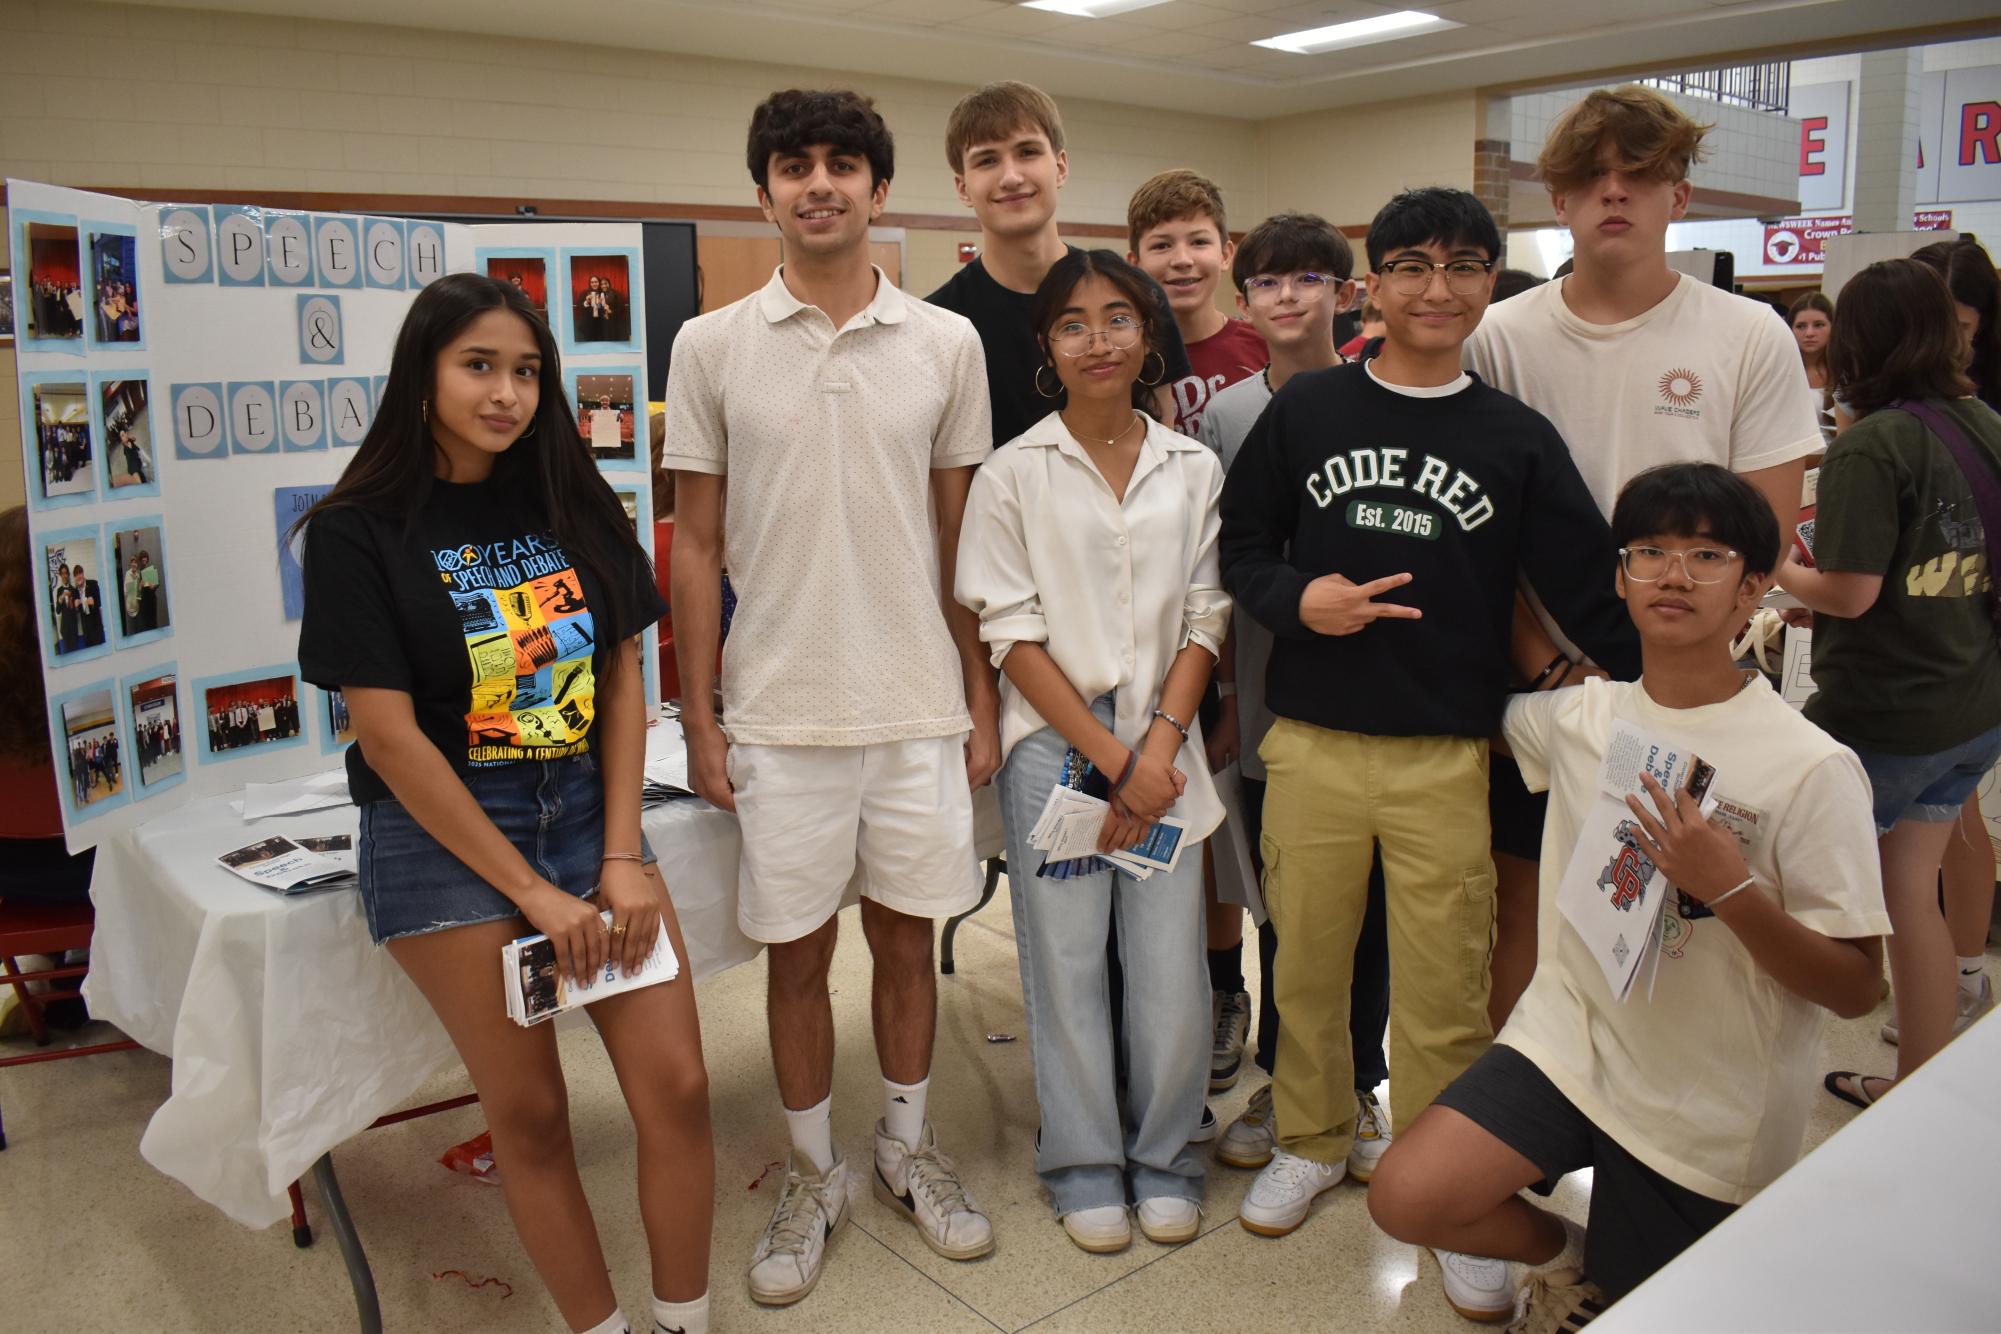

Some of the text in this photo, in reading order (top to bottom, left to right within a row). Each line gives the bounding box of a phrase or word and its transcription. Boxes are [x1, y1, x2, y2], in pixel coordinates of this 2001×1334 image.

[1815, 218, 1839, 227] Names
[1918, 213, 1950, 222] Schools
[176, 229, 437, 273] SPEECH
[307, 310, 336, 349] &
[186, 397, 363, 439] DEBA
[1306, 447, 1495, 532] CODE RED
[1355, 503, 1432, 536] Est. 2015
[440, 549, 570, 591] OF SPEECH AND DEBATE
[468, 745, 524, 761] CELEBRATING
[525, 747, 533, 760] A
[1640, 744, 1660, 794] Debe
[1661, 751, 1677, 792] Spee
[1653, 768, 1663, 779] &
[1723, 804, 1759, 825] RELIGION
